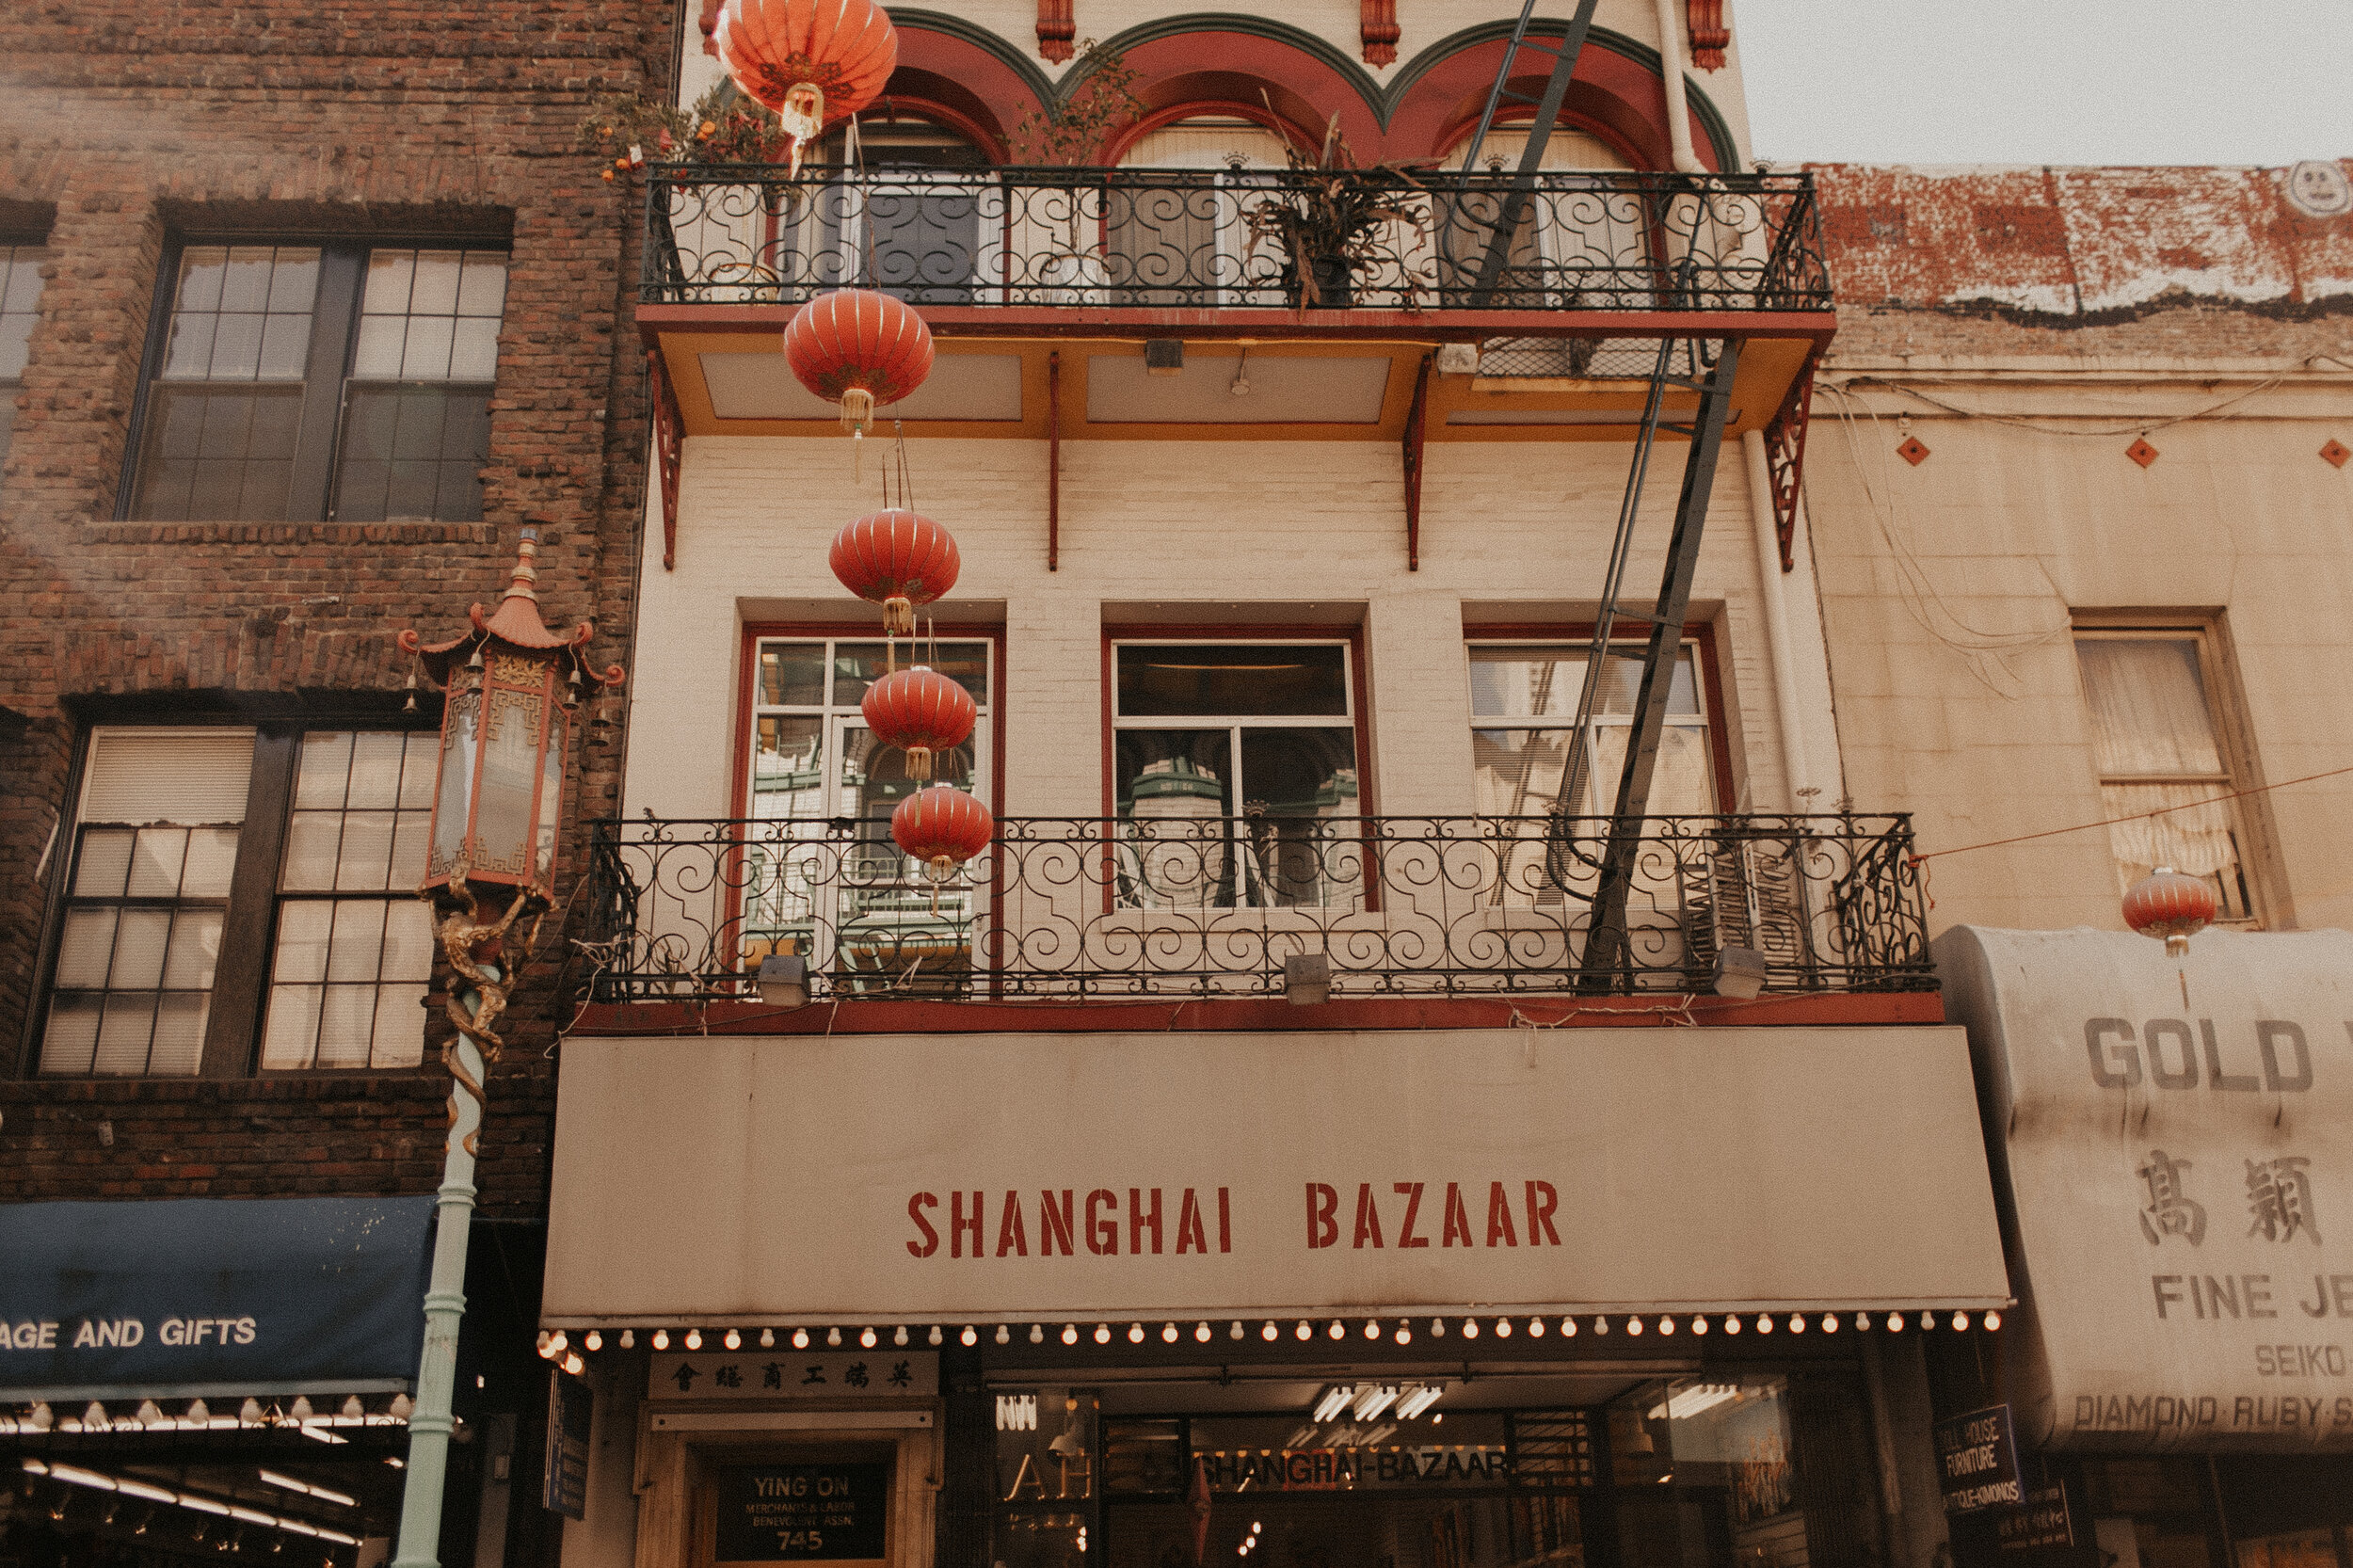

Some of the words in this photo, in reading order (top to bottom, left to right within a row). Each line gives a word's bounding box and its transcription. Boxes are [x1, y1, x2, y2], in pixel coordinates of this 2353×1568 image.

[2083, 1017, 2314, 1092] GOLD
[905, 1187, 1232, 1258] SHANGHAI
[1305, 1180, 1562, 1250] BAZAAR
[2152, 1274, 2279, 1319] FINE
[72, 1318, 145, 1349] AND
[159, 1316, 257, 1346] GIFTS
[2255, 1344, 2347, 1377] SEIKO
[1945, 1444, 1998, 1478] FURNITURE
[754, 1476, 808, 1497] YING
[816, 1476, 850, 1497] ON
[776, 1530, 824, 1552] 745
